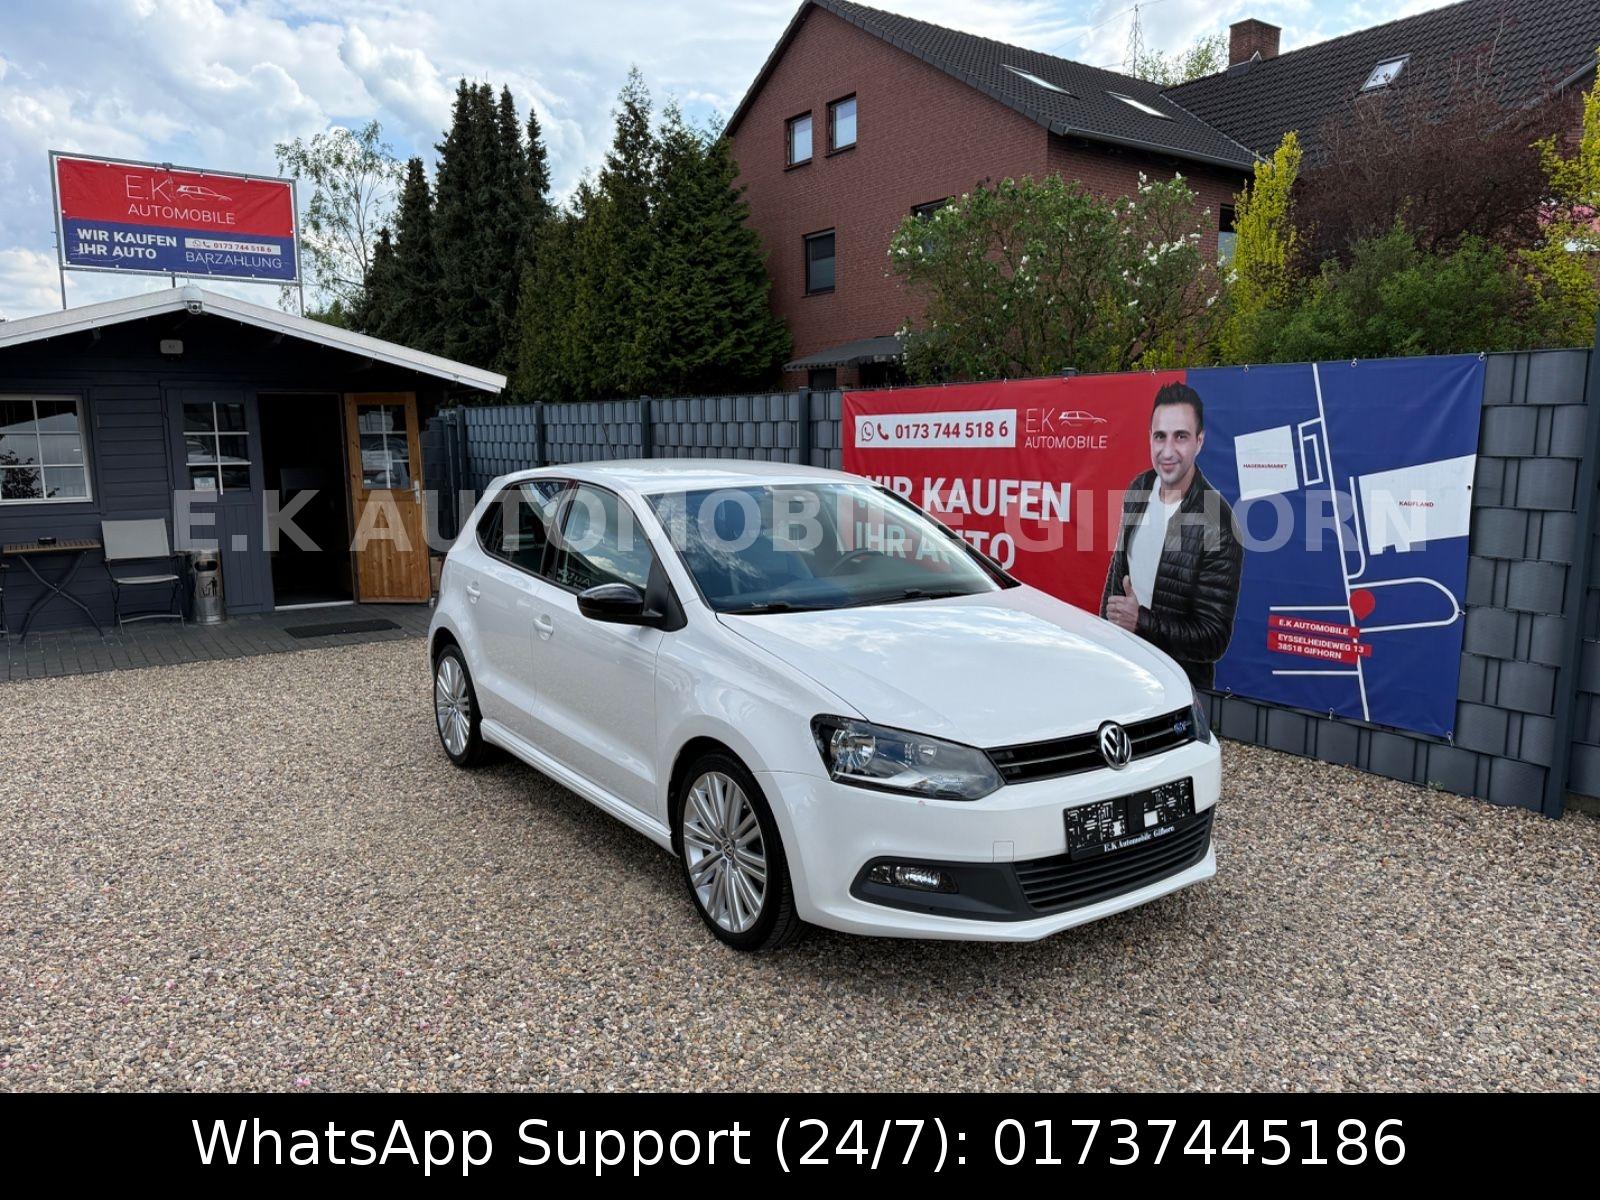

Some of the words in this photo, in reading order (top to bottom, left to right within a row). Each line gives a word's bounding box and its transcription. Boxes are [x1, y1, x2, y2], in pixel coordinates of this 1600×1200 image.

[125, 174, 171, 202] E.K
[128, 203, 236, 225] AUTOMOBILE
[77, 228, 109, 242] WIR
[113, 231, 177, 247] KAUFEN
[213, 242, 233, 250] 0173
[235, 243, 250, 251] 744
[79, 242, 108, 256] IHR
[112, 245, 157, 259] AUTO
[185, 251, 282, 268] BARZAHLUNG
[895, 424, 930, 439] 0173
[933, 422, 960, 438] 744
[965, 421, 994, 438] 518
[999, 420, 1008, 437] 6
[1025, 407, 1055, 433] E.K
[1025, 435, 1108, 449] AUTOMOBILE
[923, 476, 1072, 523] KAUFEN
[855, 521, 907, 559] IHR
[1278, 619, 1292, 628] E.K
[1293, 622, 1349, 636] AUTOMOBILE
[1277, 642, 1303, 653] 38518
[1303, 646, 1342, 659] GIFHORN
[1278, 633, 1351, 652] EYSSELHEIDEWEG
[1353, 645, 1364, 653] 13
